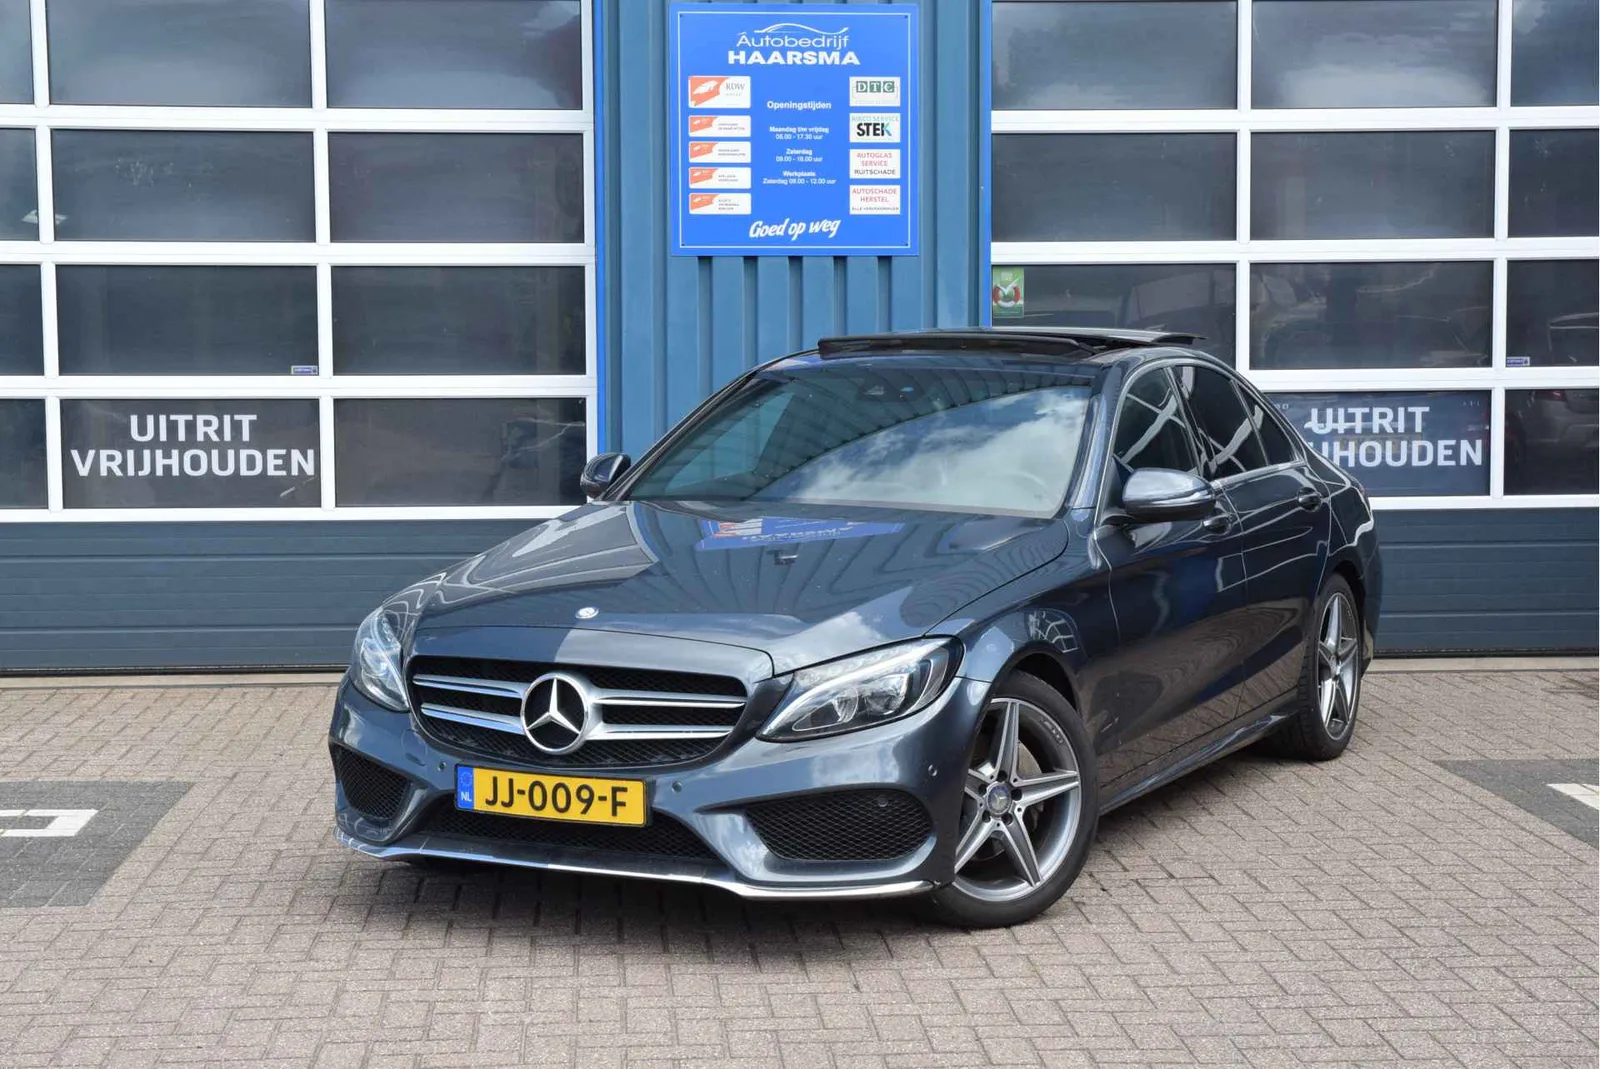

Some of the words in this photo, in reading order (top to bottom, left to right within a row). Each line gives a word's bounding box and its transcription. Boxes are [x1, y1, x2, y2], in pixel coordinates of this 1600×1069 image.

[736, 34, 849, 50] Autobedrijf
[728, 50, 860, 65] HAARSMA
[856, 81, 894, 93] DTC
[767, 101, 831, 110] Openingstijden
[856, 122, 892, 137] STEK
[749, 218, 790, 239] Goed
[788, 222, 807, 241] op
[808, 219, 842, 239] weg
[129, 414, 258, 442] UITRIT
[1310, 407, 1430, 434] UITRIT
[70, 449, 316, 477] VRIJHOUDEN
[461, 791, 472, 802] NL
[485, 776, 628, 817] JJ-009-F
